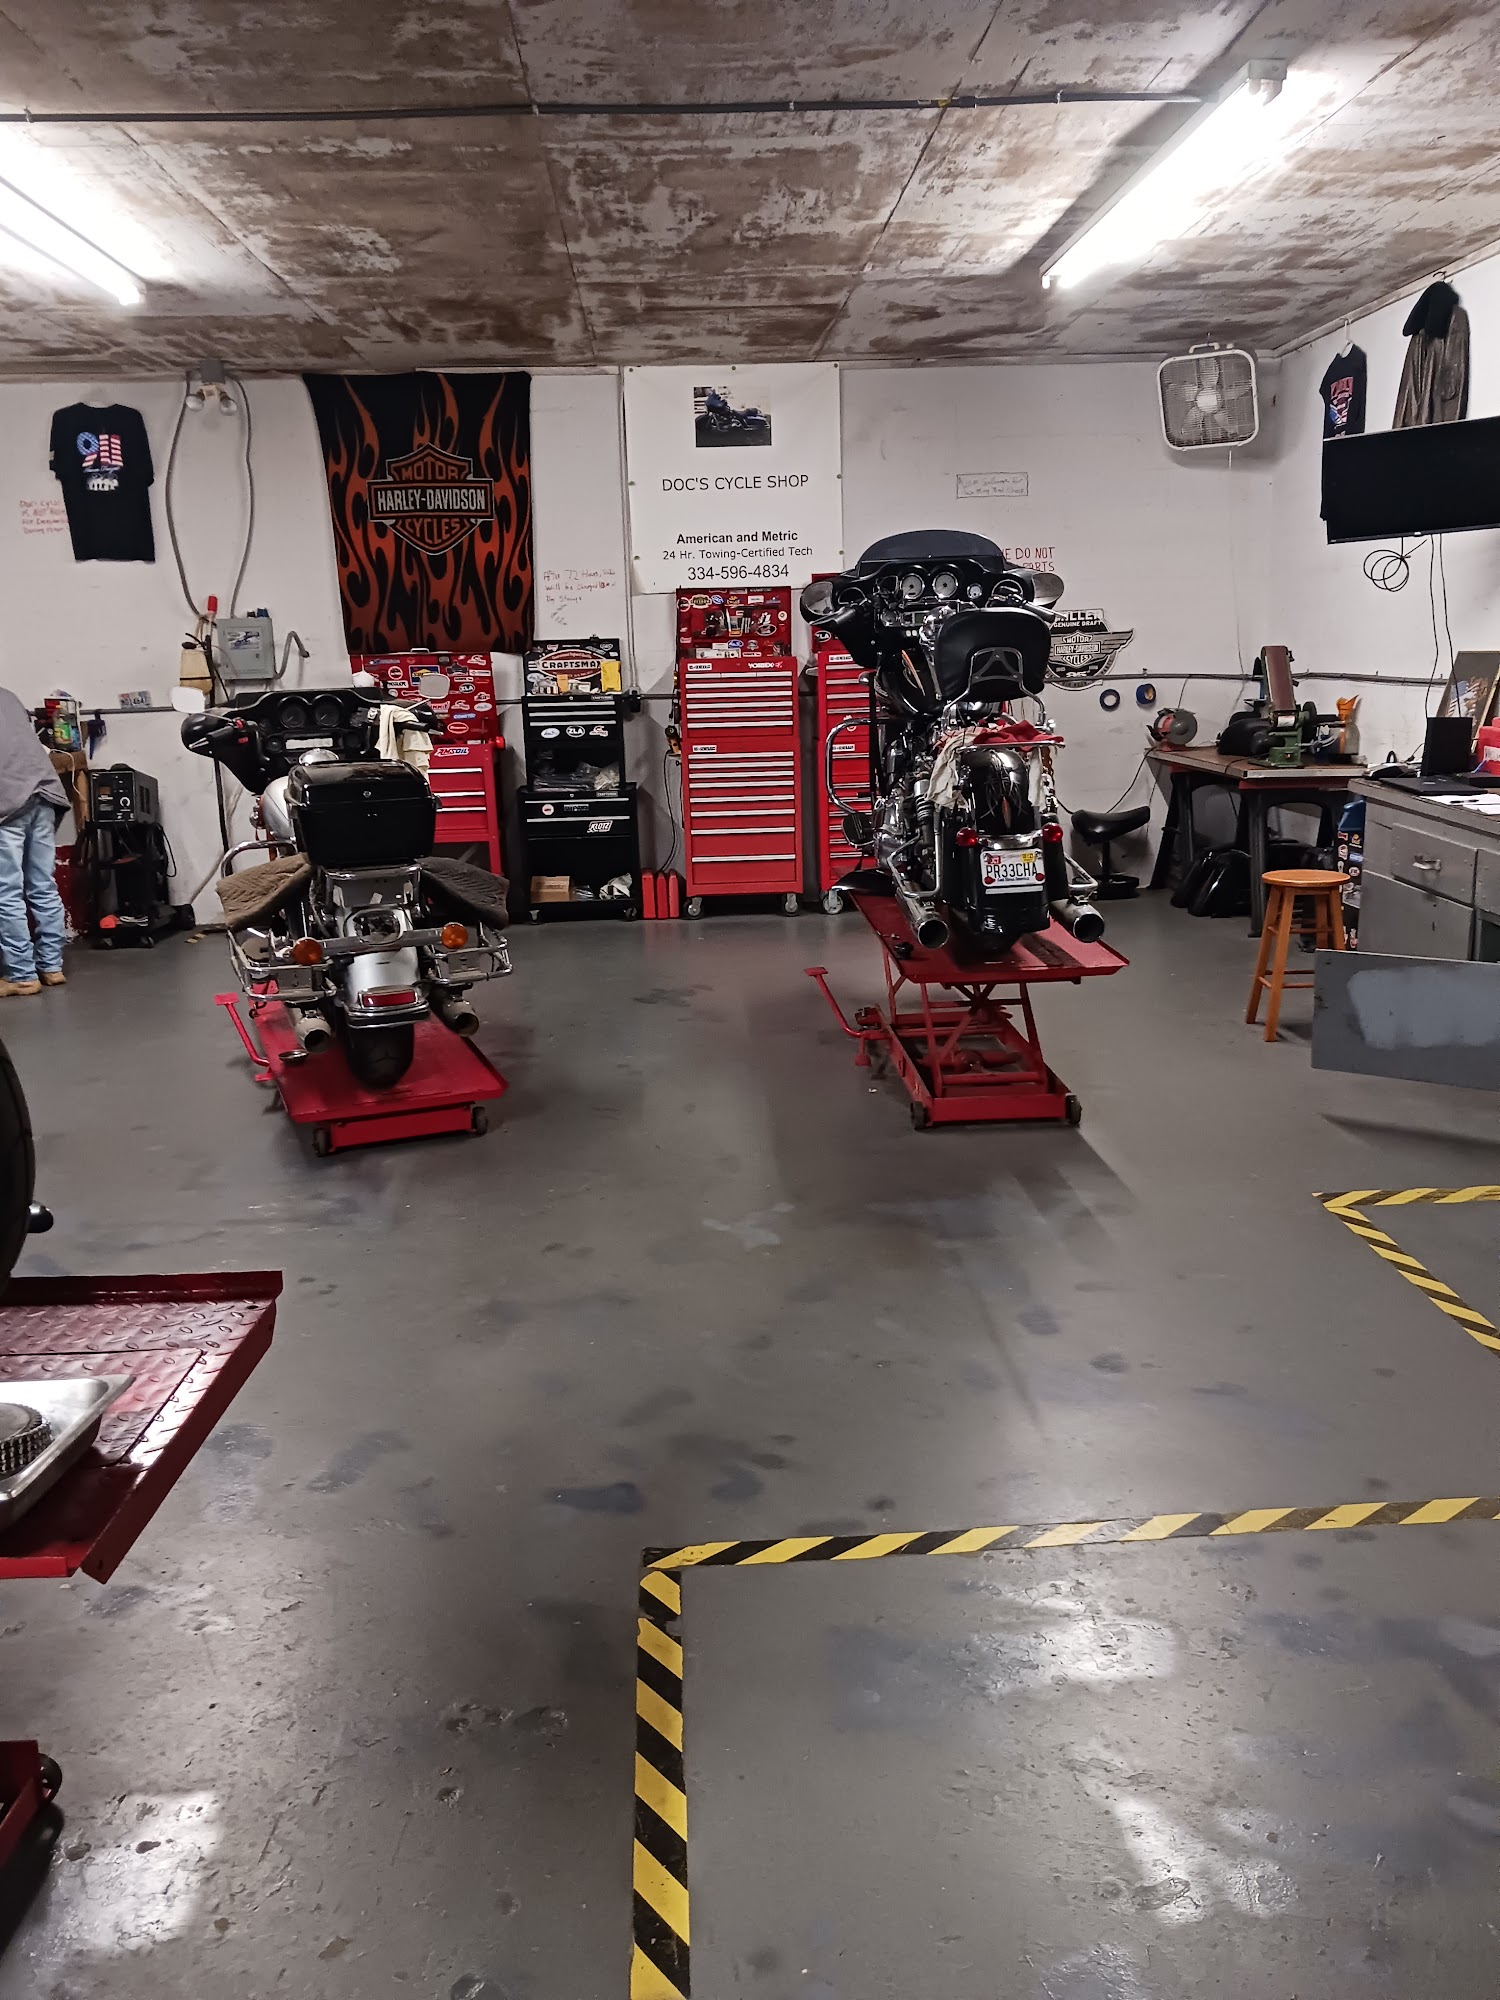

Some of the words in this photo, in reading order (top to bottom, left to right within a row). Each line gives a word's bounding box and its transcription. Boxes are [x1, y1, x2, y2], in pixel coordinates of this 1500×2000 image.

[401, 456, 459, 480] MOTOR
[662, 477, 709, 491] DOC'S
[714, 476, 762, 489] CYCLE
[767, 474, 809, 488] SHOP
[377, 488, 486, 511] HARLEY-DAVIDSON
[405, 518, 460, 544] CYCLES
[676, 532, 733, 544] American
[736, 531, 758, 543] and
[762, 530, 798, 542] Metric
[663, 550, 676, 560] 24
[680, 550, 695, 559] Hr.
[698, 547, 785, 560] Towing-Certified
[788, 546, 813, 556] Tech
[1015, 547, 1031, 560] DO
[1035, 547, 1056, 559] NOT
[688, 563, 789, 580] 334-596-4834
[1066, 633, 1089, 643] MOTOR
[1066, 654, 1090, 665] CYCLES
[438, 747, 468, 756] AMSOIL
[590, 822, 610, 831] KLOTZ
[986, 863, 1037, 878] PR33CHA
